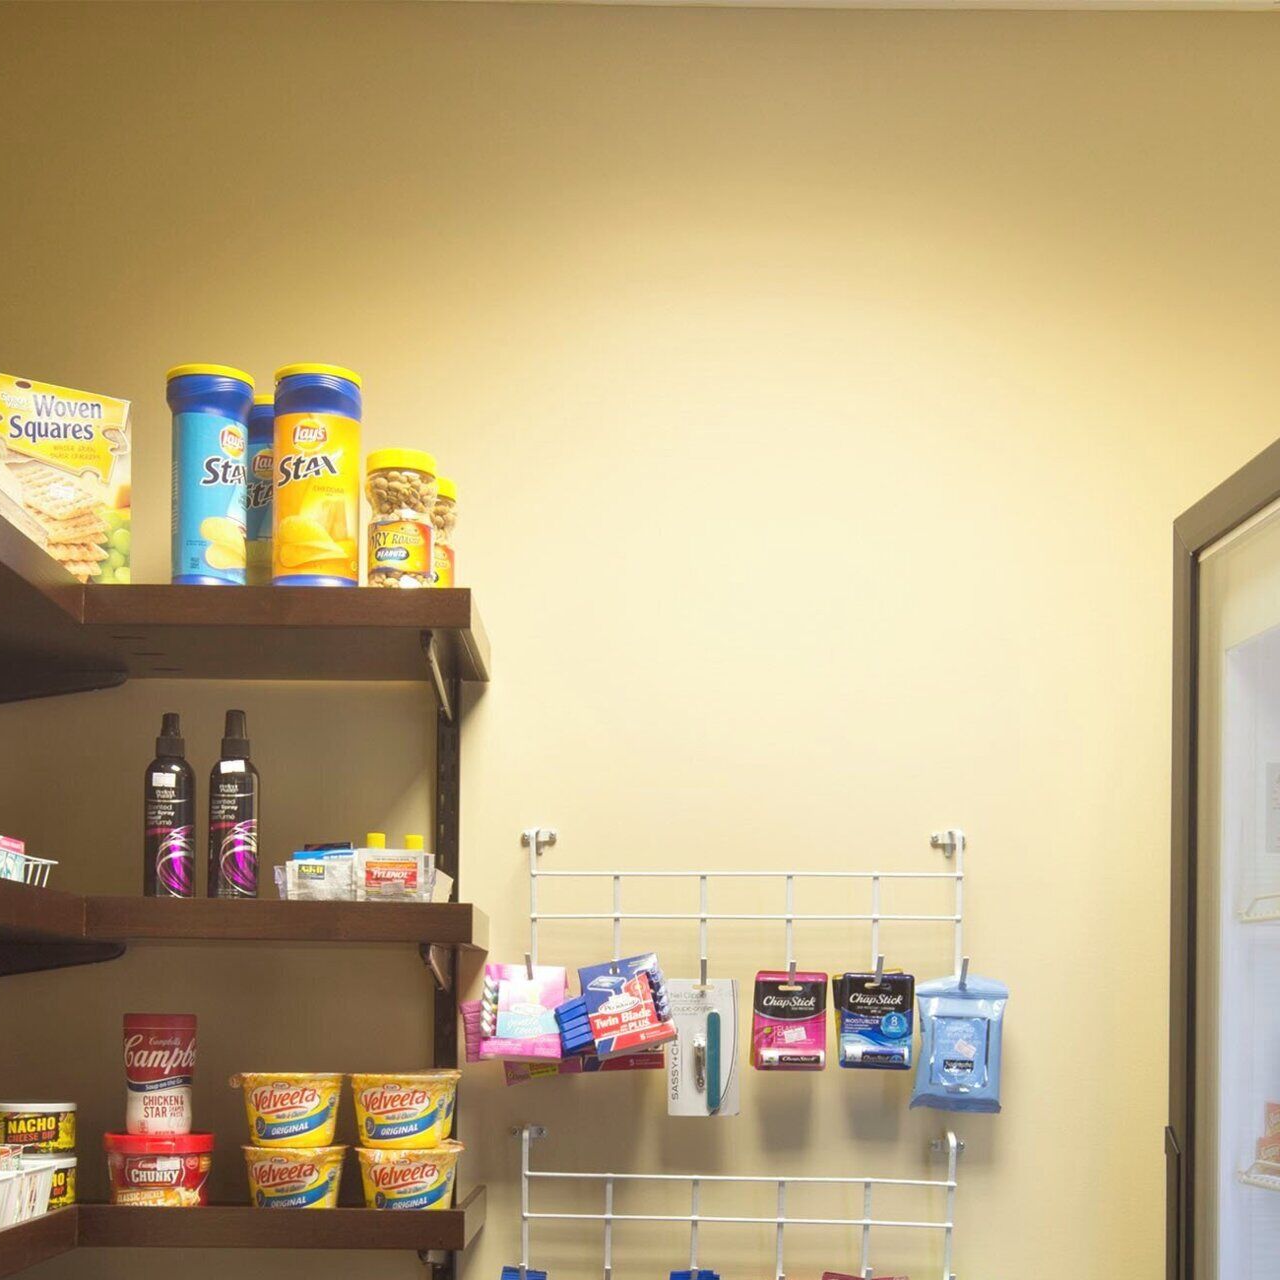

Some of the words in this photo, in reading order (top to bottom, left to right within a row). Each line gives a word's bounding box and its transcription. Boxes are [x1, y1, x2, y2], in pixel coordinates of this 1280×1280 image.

[32, 394, 102, 419] Woven
[9, 415, 94, 443] Squares
[295, 425, 326, 442] Lay's
[372, 869, 408, 878] TYLENOL
[763, 995, 816, 1008] ChapStick
[849, 993, 903, 1005] ChapStick
[593, 1016, 618, 1029] Twin
[620, 1008, 651, 1021] Blade
[628, 1018, 649, 1030] PLUS
[891, 1016, 898, 1026] 8
[143, 1095, 179, 1107] CHICKEN
[253, 1088, 317, 1114] Velveeta
[363, 1089, 427, 1115] Velveeta
[143, 1107, 167, 1118] STAR
[8, 1116, 56, 1134] NACHO
[271, 1122, 309, 1136] ORIGINAL
[380, 1123, 418, 1136] ORIGINAL
[7, 1132, 38, 1142] CHEESE
[41, 1130, 56, 1139] DIP
[131, 1169, 178, 1184] CHUNKY
[252, 1163, 316, 1188] Velveeta
[373, 1164, 437, 1188] Velveeta
[271, 1197, 307, 1208] ORIGINAL
[392, 1197, 428, 1209] ORIGINAL
